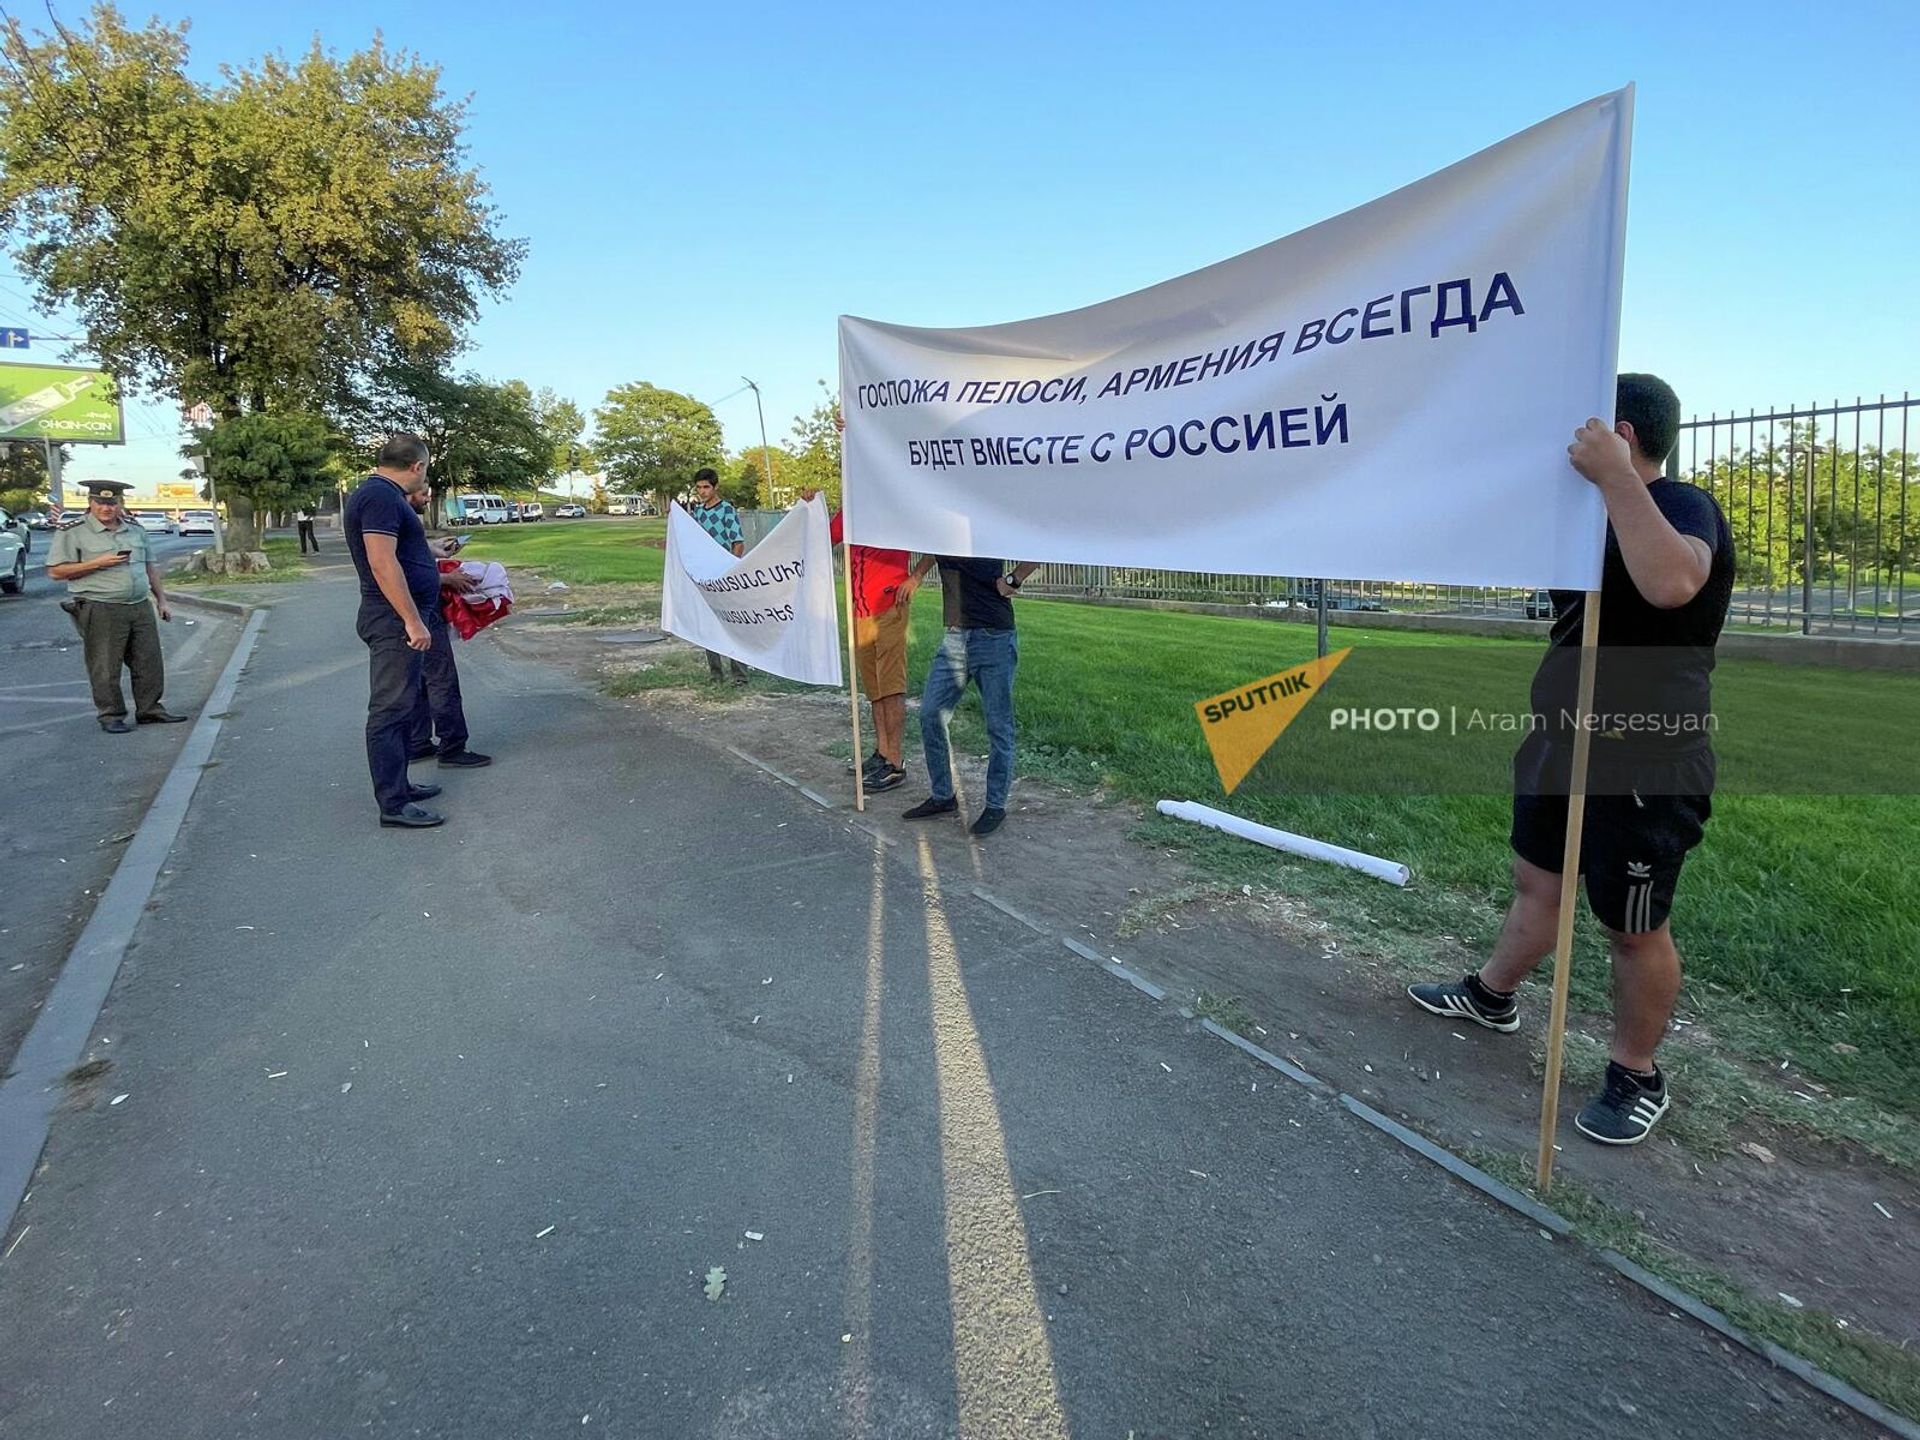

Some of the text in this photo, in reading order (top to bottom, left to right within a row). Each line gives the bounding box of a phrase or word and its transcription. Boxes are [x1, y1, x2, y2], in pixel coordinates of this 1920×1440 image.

[858, 272, 1526, 409] ГОСПОЖА ПЕЛОСИ, АРМЕНИЯ ВСЕГДА
[908, 393, 1350, 470] БУДЕТ ВМЕСТЕ С РОССИЕЙ
[768, 559, 804, 583] ՄԻՇ
